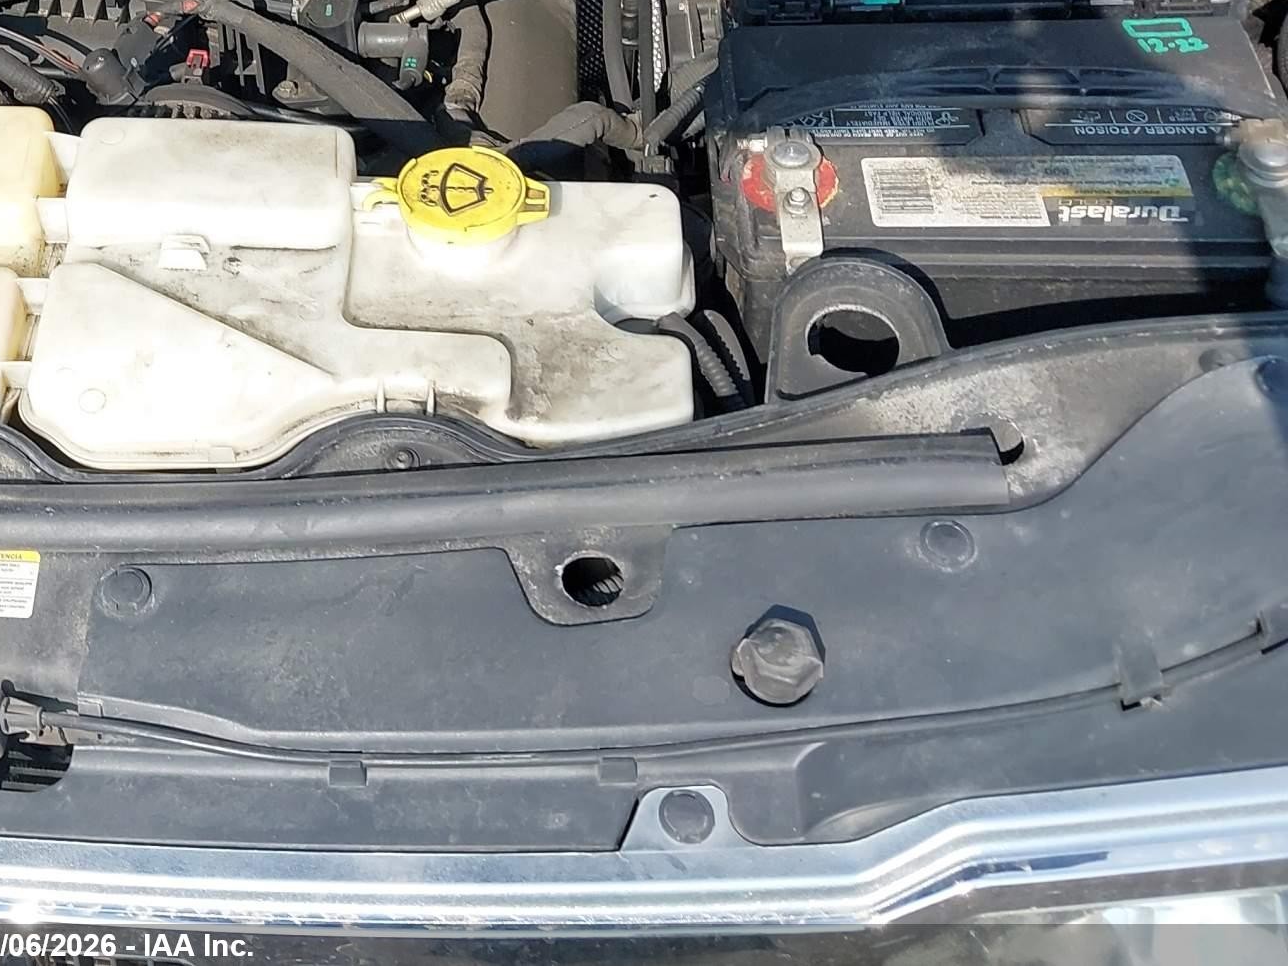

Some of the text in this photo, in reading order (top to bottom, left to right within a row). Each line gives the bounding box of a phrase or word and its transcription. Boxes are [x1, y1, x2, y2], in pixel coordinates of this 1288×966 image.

[1074, 126, 1129, 135] POISON
[1145, 126, 1207, 135] DANGER
[1058, 205, 1189, 222] Duralast
